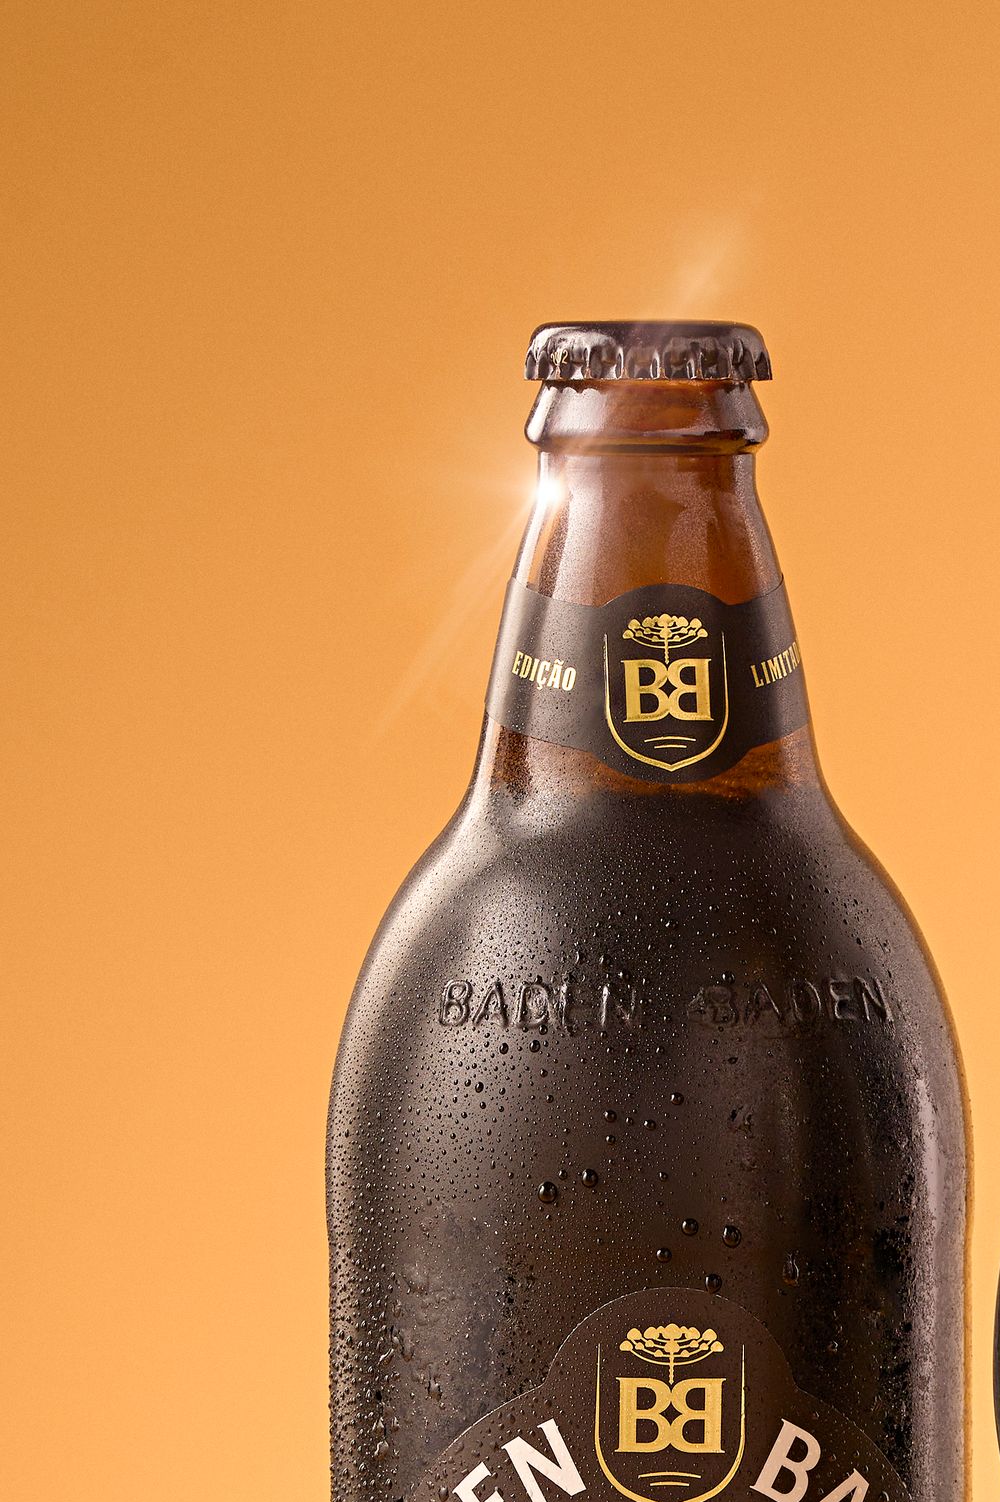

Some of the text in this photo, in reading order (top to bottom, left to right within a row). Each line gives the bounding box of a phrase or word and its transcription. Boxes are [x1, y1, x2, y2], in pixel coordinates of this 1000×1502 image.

[511, 650, 577, 692] EDIÇÃO
[439, 976, 895, 1028] BADEN BADEN
